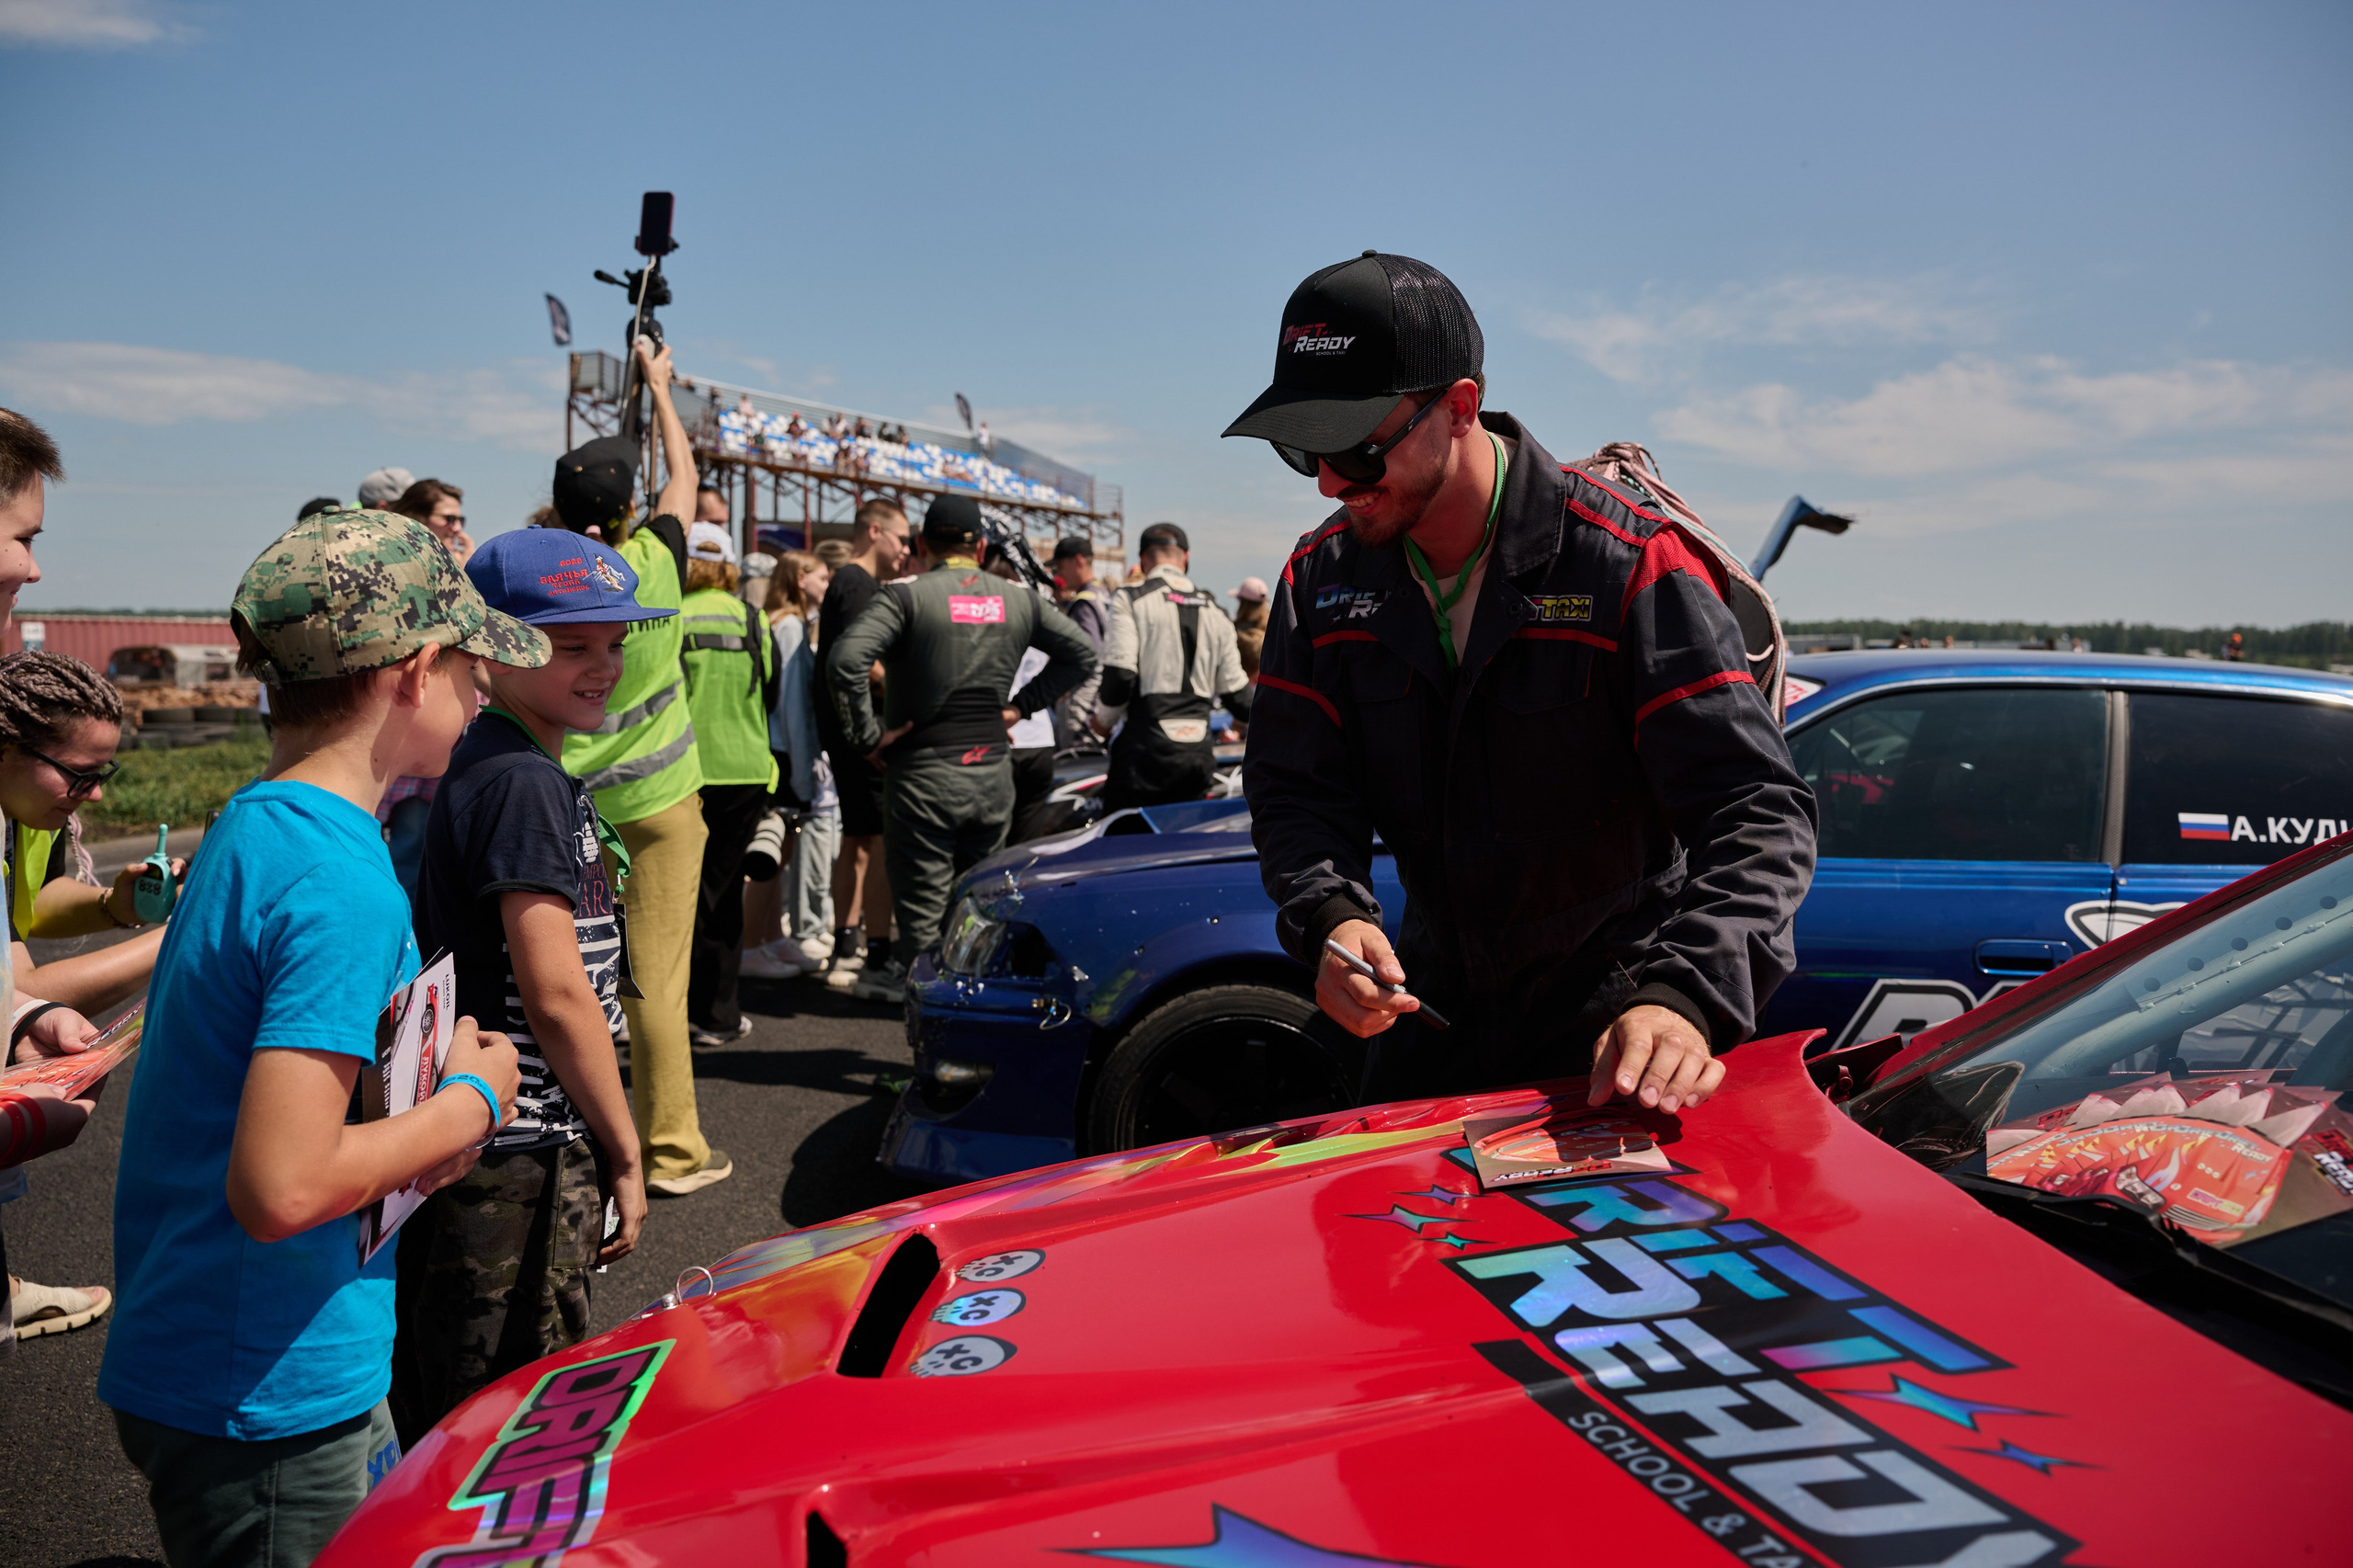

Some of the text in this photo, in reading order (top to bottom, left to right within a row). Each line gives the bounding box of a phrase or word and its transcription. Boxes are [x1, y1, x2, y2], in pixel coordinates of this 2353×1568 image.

[1293, 335, 1357, 354] READY
[539, 569, 588, 585] ЗАЯЧЬЯ
[552, 579, 581, 589] ТРОПА
[1541, 598, 1591, 619] TAXI
[417, 1055, 430, 1104] ЛУКОЙ
[2230, 1142, 2274, 1165] READY
[1568, 1411, 1711, 1513] SCHOOL
[1701, 1513, 1746, 1537] &
